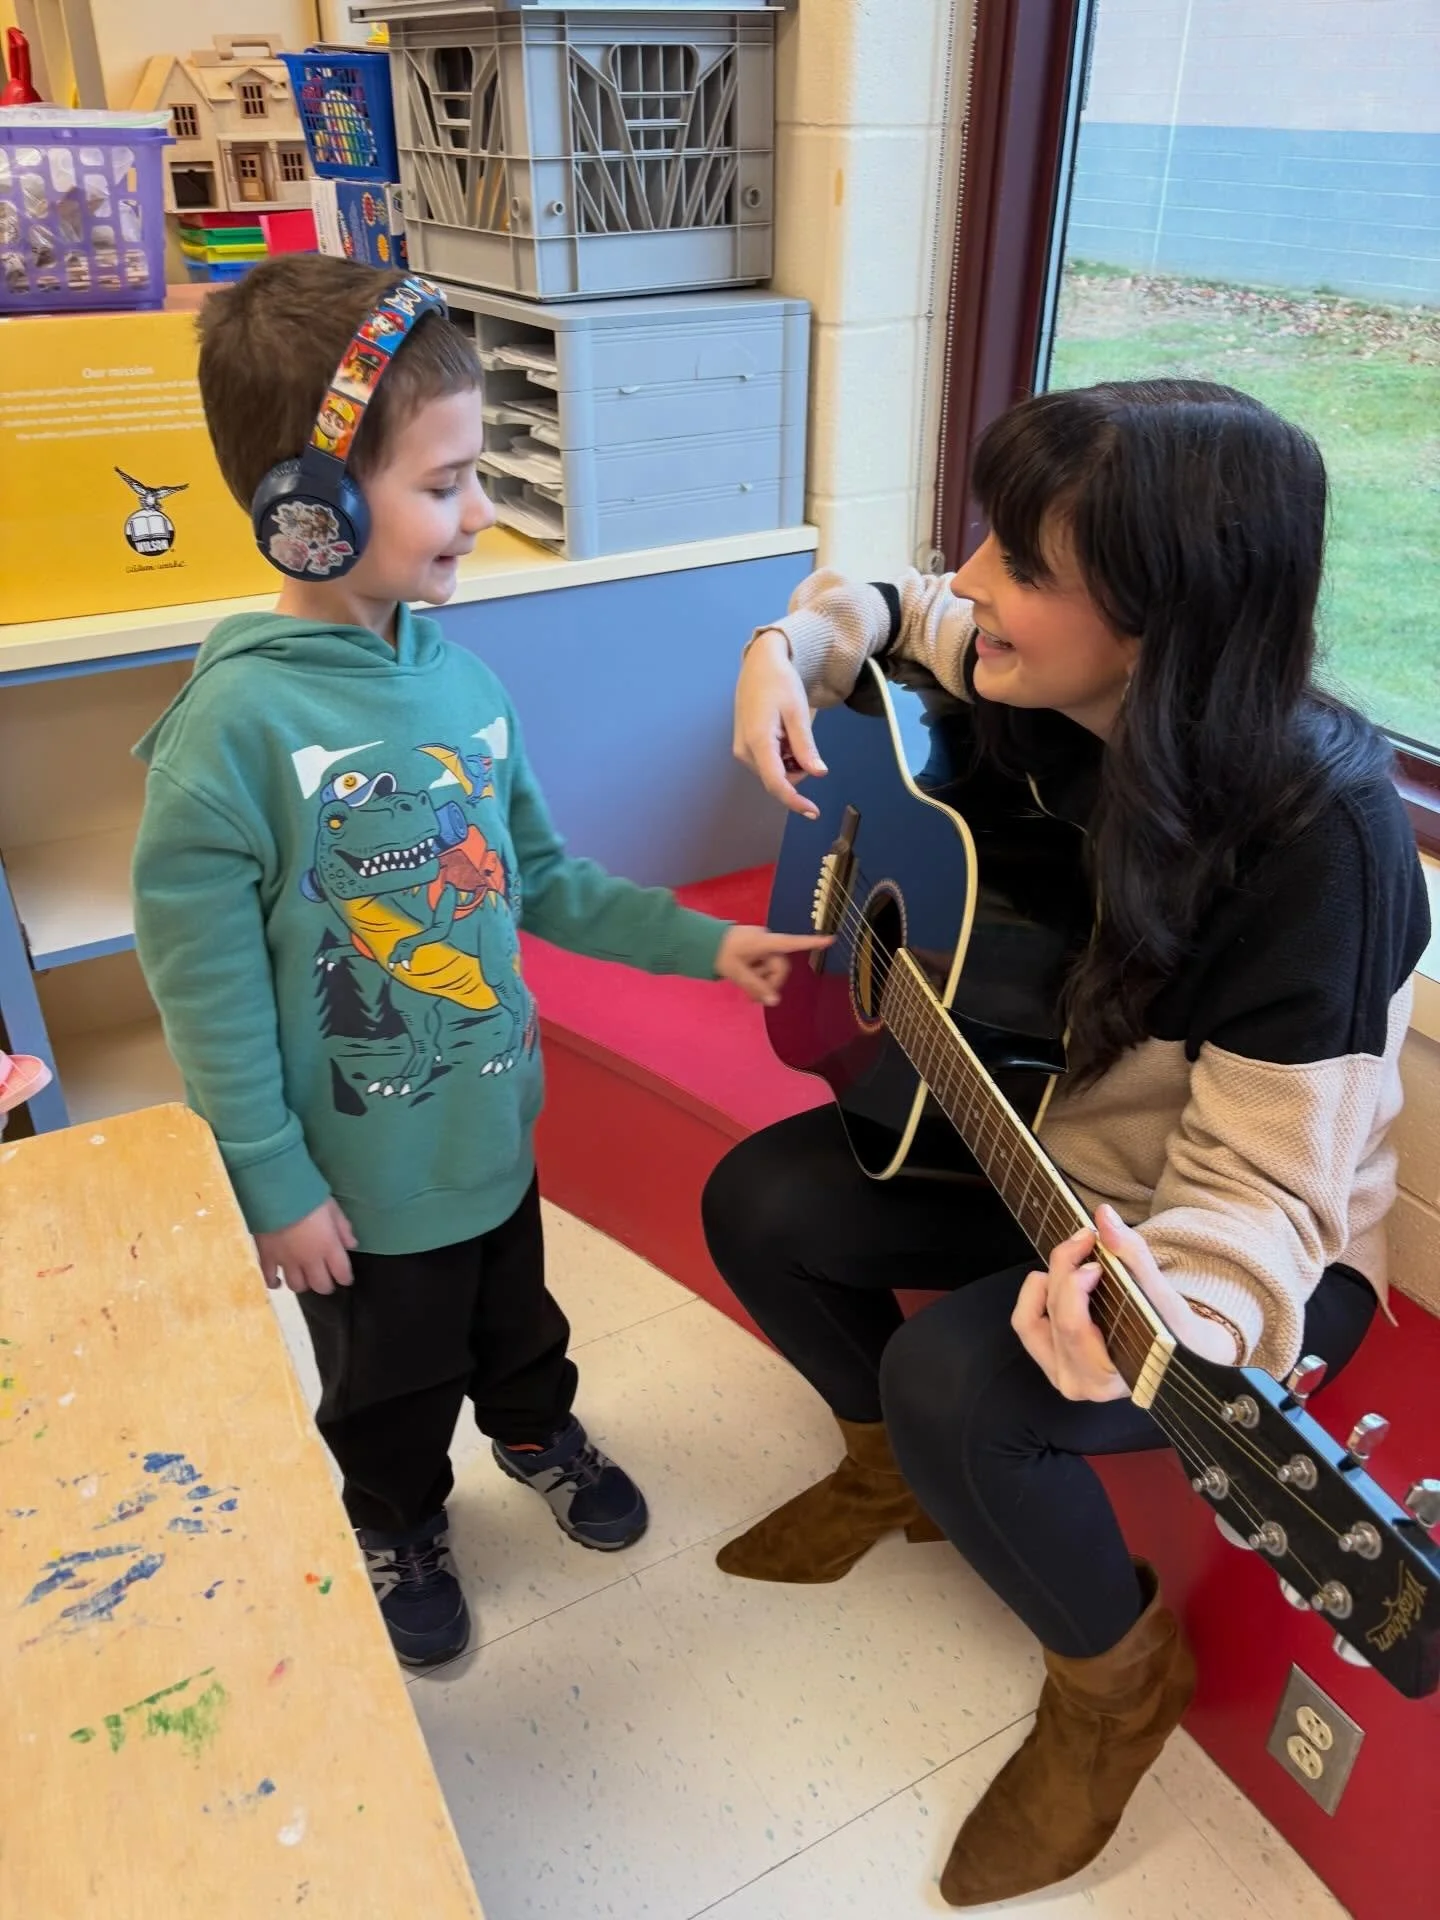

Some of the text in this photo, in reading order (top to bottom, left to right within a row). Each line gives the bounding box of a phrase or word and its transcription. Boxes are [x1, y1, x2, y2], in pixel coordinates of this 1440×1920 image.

[82, 366, 154, 378] Our mission
[135, 539, 169, 552] WILSON
[1367, 1565, 1428, 1652] Washburn
